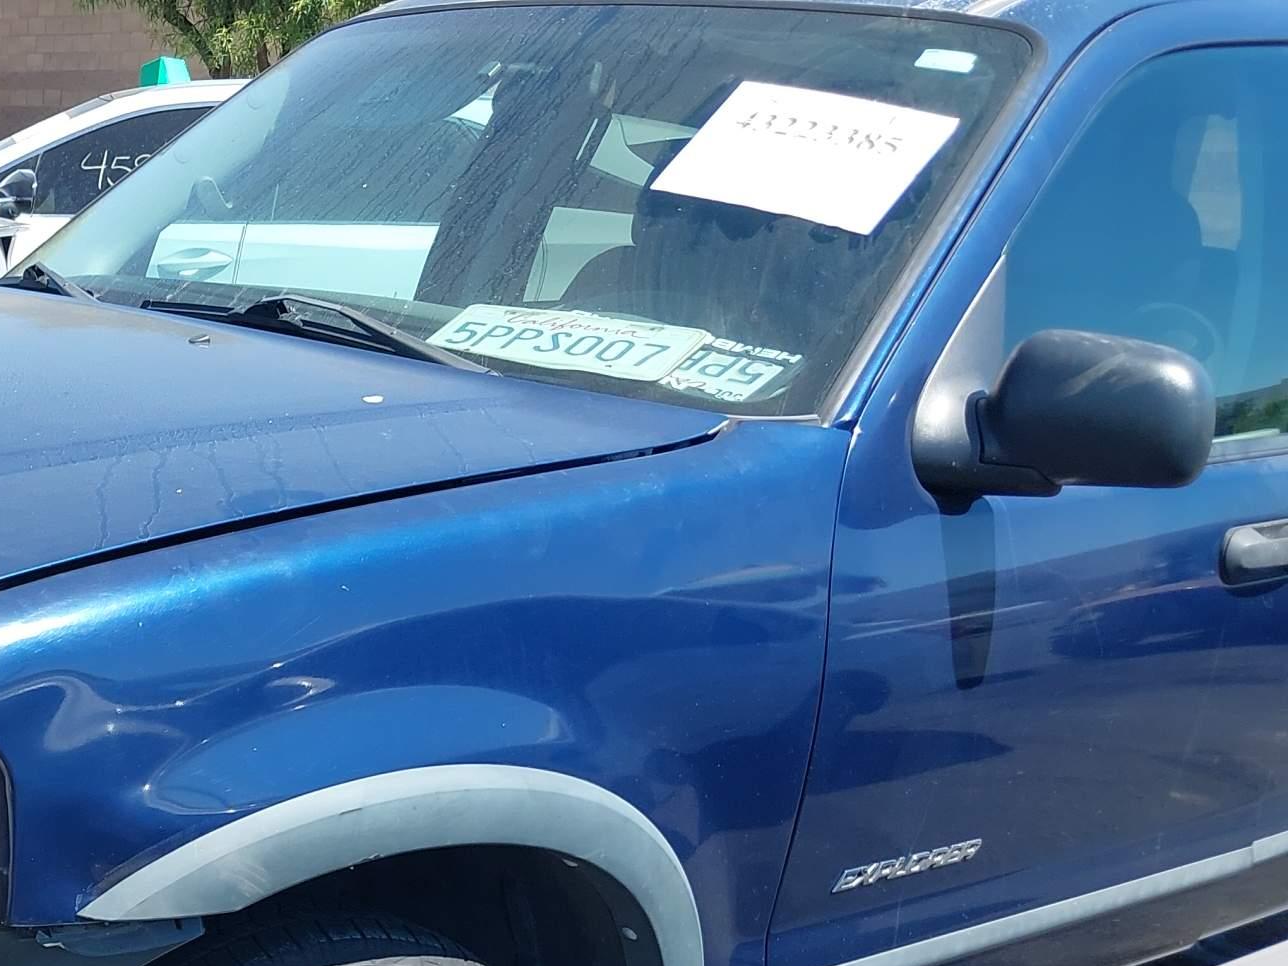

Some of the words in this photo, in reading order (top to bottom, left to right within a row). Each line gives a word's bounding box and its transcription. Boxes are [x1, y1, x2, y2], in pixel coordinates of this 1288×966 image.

[735, 111, 904, 155] 43223385
[445, 321, 671, 367] 5PPS007
[506, 312, 649, 338] California
[831, 838, 983, 893] EXPLORER
